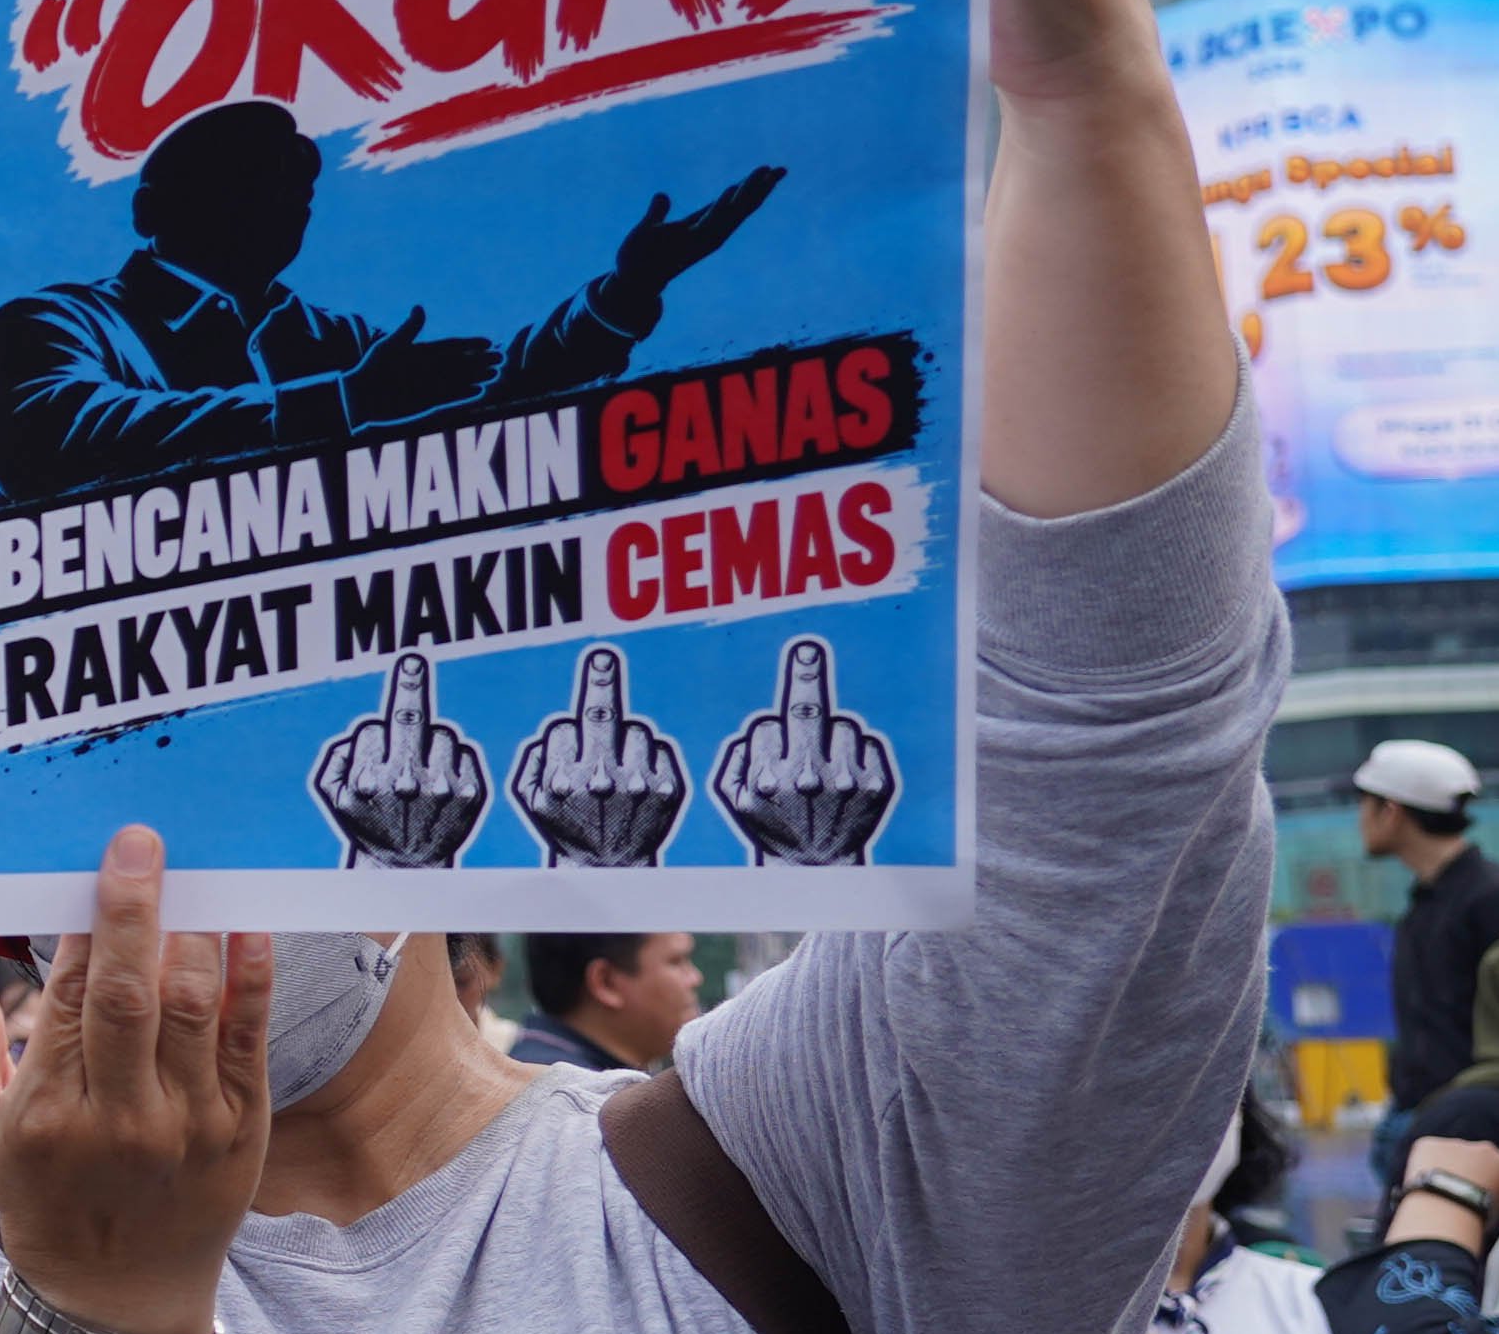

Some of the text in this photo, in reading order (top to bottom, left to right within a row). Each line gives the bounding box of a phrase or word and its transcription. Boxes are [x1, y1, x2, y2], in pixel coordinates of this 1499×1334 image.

[348, 407, 580, 539] MAKIN
[599, 348, 893, 493] GANAS
[4, 481, 897, 726] RAKYAT MAKIN CEMAS
